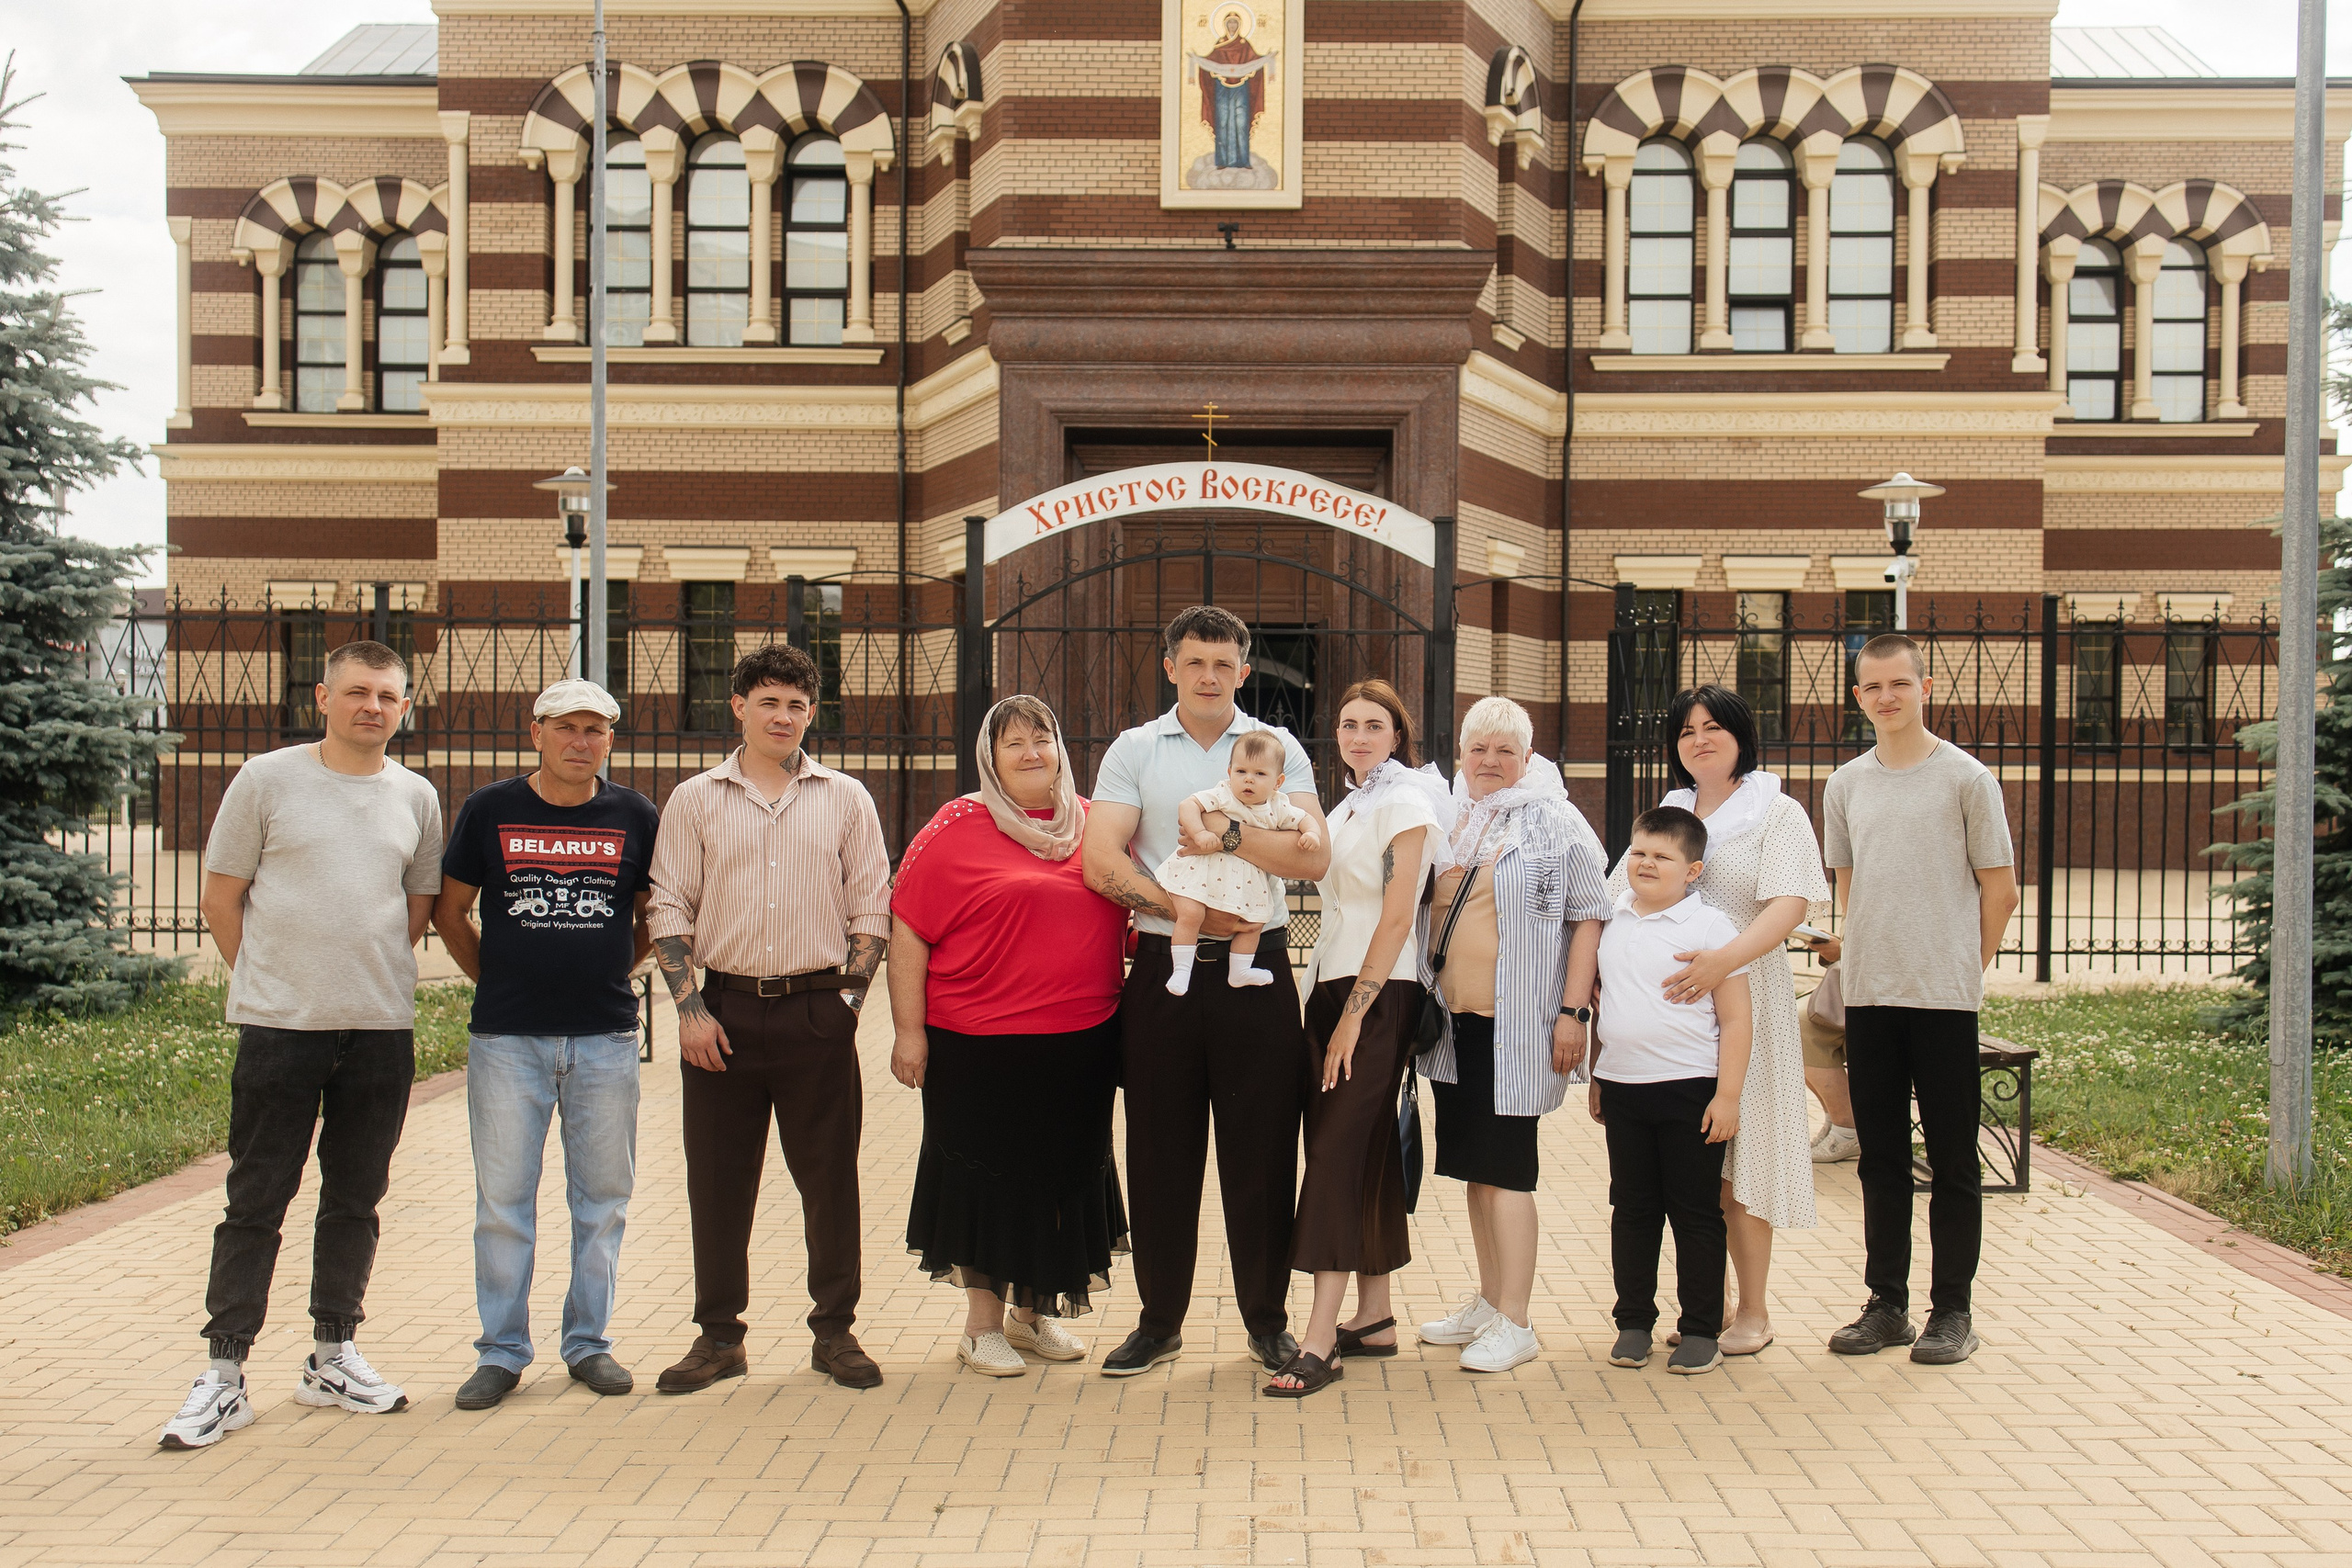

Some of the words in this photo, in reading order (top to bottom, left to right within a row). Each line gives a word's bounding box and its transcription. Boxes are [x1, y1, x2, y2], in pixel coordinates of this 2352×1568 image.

[509, 838, 616, 856] BELARU'S
[510, 874, 542, 885] Quality
[545, 874, 580, 886] Design
[582, 875, 616, 887] Clothing
[521, 919, 551, 930] Original
[552, 920, 605, 930] Vyshyvankees
